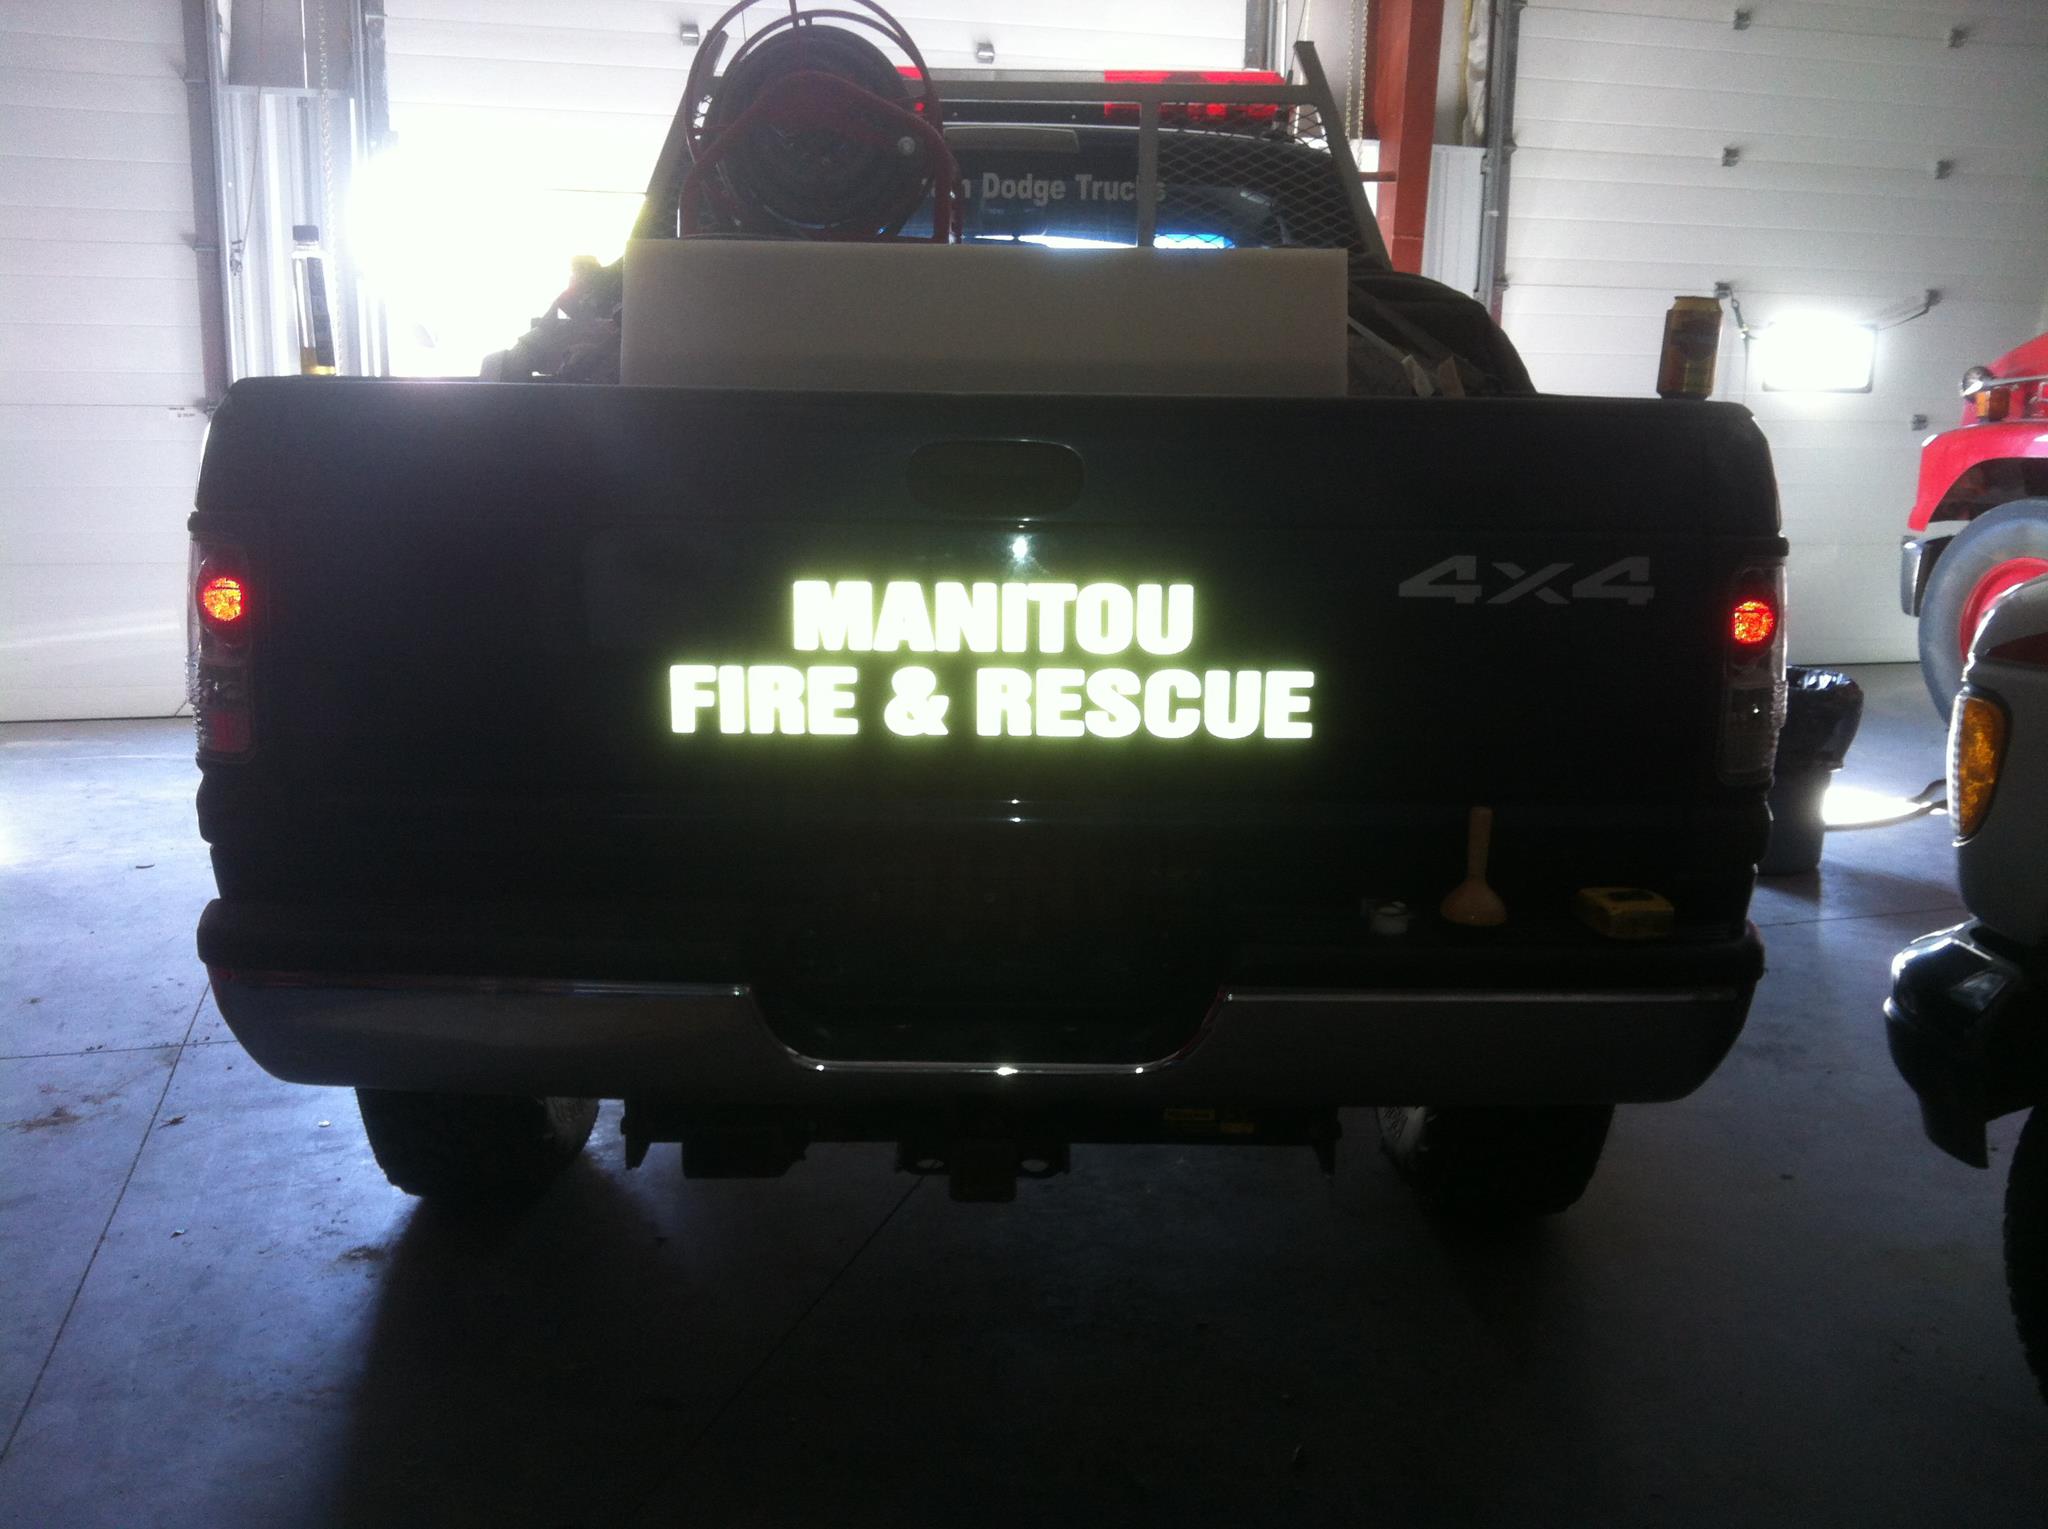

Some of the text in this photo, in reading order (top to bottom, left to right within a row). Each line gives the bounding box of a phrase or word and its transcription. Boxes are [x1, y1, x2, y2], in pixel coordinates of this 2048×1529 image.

[982, 172, 1066, 206] Dodge
[1075, 174, 1167, 201] Trucs
[793, 580, 1195, 655] MANITOU
[669, 664, 1315, 740] FIRE & RESCUE
